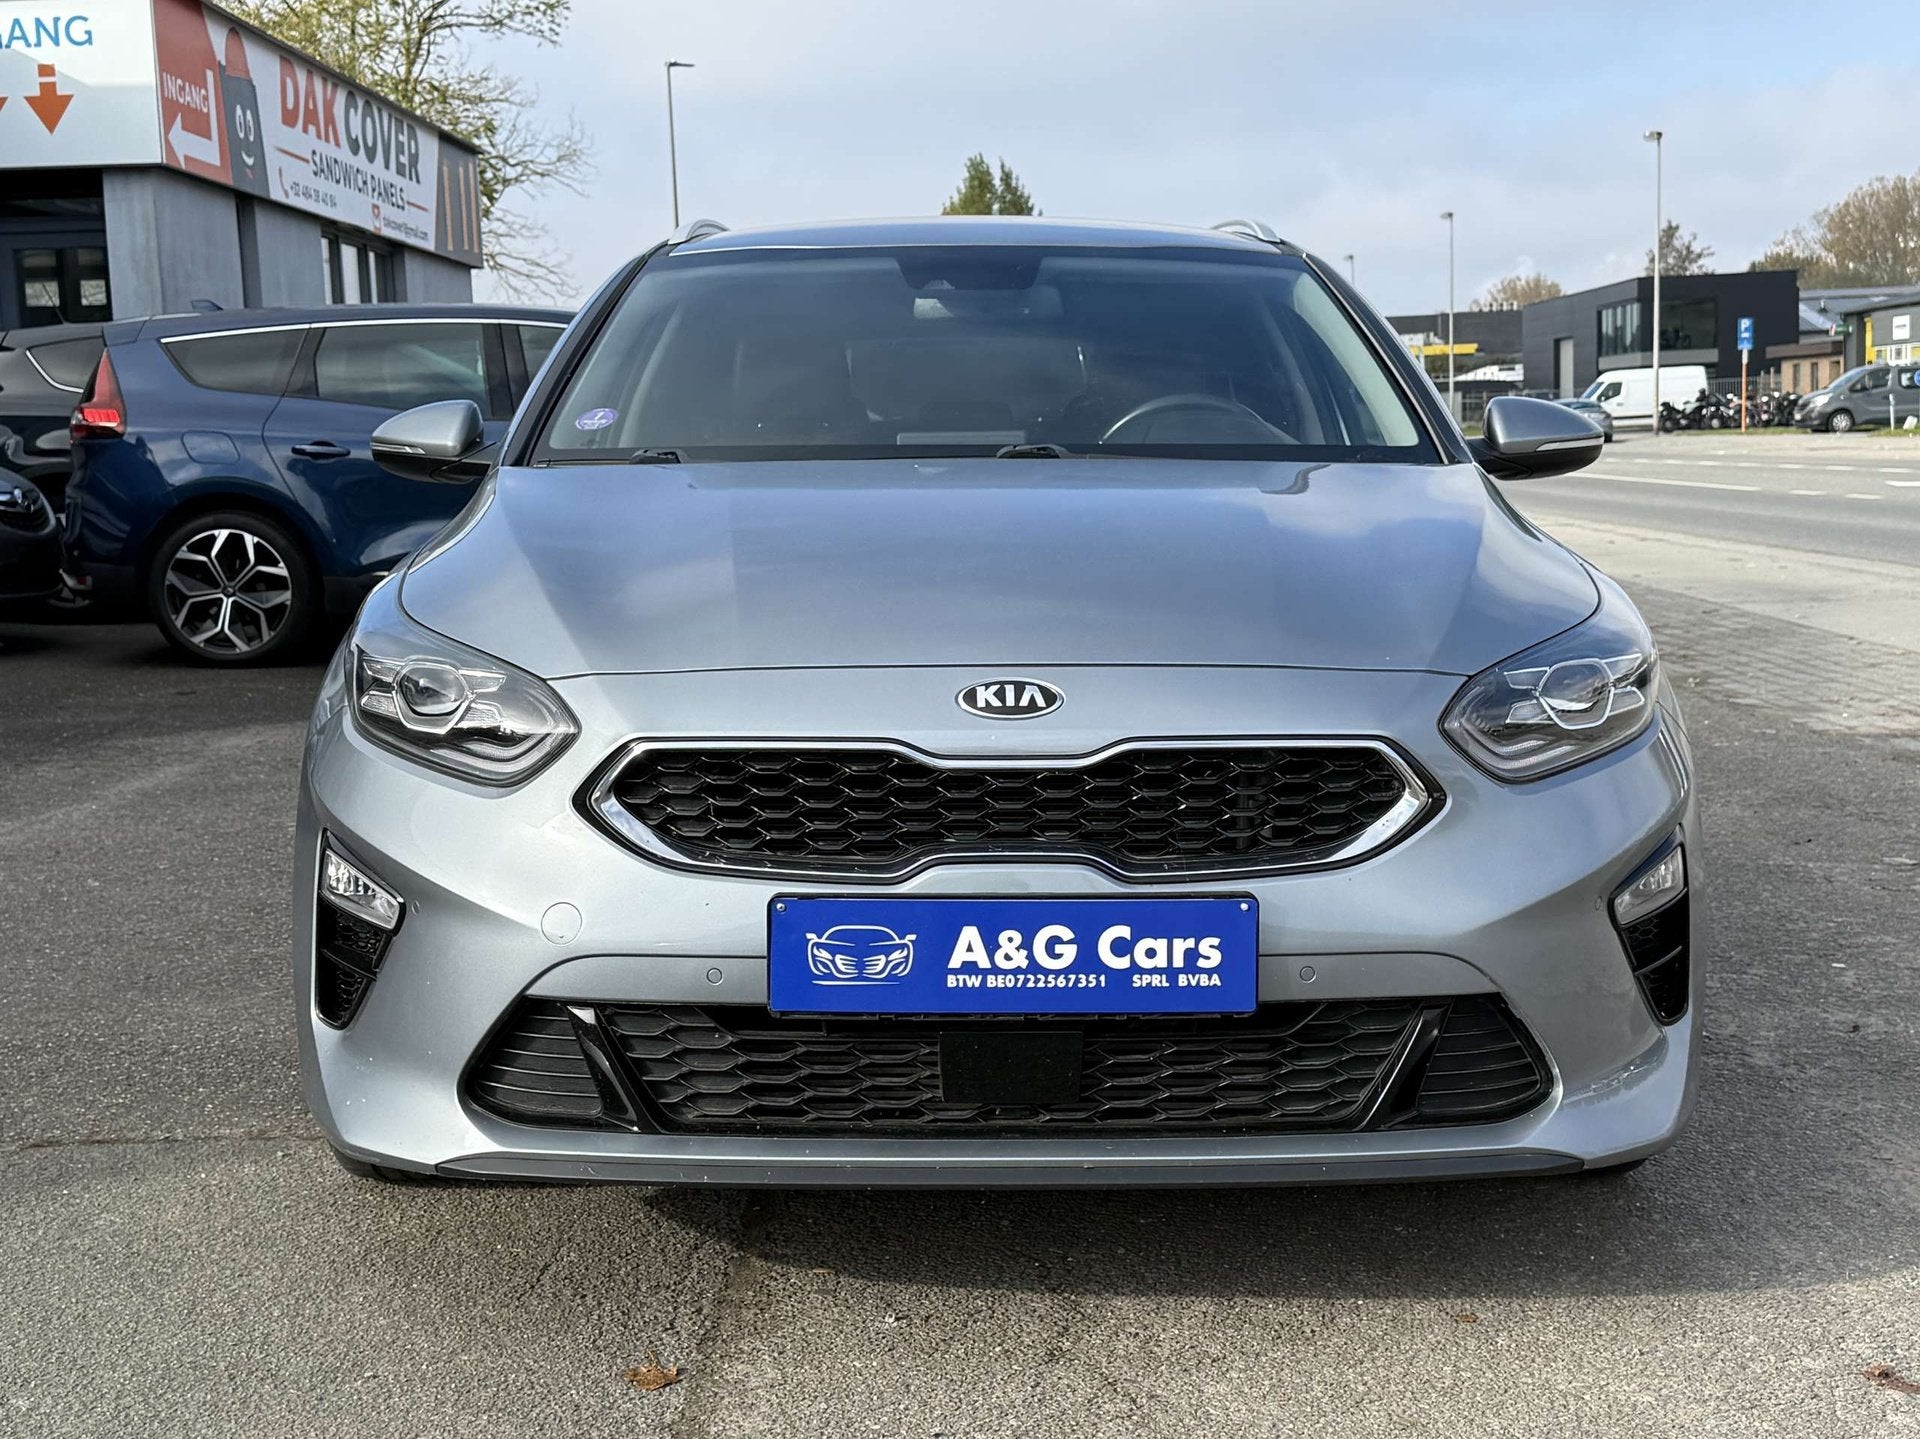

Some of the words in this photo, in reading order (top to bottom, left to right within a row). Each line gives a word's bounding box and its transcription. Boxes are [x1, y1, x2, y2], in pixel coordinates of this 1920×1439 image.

[0, 15, 93, 49] ANG
[162, 72, 209, 113] INGANG
[279, 54, 342, 150] DAK
[344, 90, 421, 184] COVER
[311, 149, 369, 197] SANDWICH
[370, 174, 406, 211] PANELS
[1741, 318, 1750, 332] P
[975, 684, 1047, 708] KIA
[947, 924, 1078, 970] A&G
[1097, 924, 1222, 970] Cars
[947, 974, 983, 988] BTW
[986, 974, 1106, 988] BE0722567351
[1132, 974, 1170, 988] SPRL
[1178, 974, 1222, 988] BVBA
